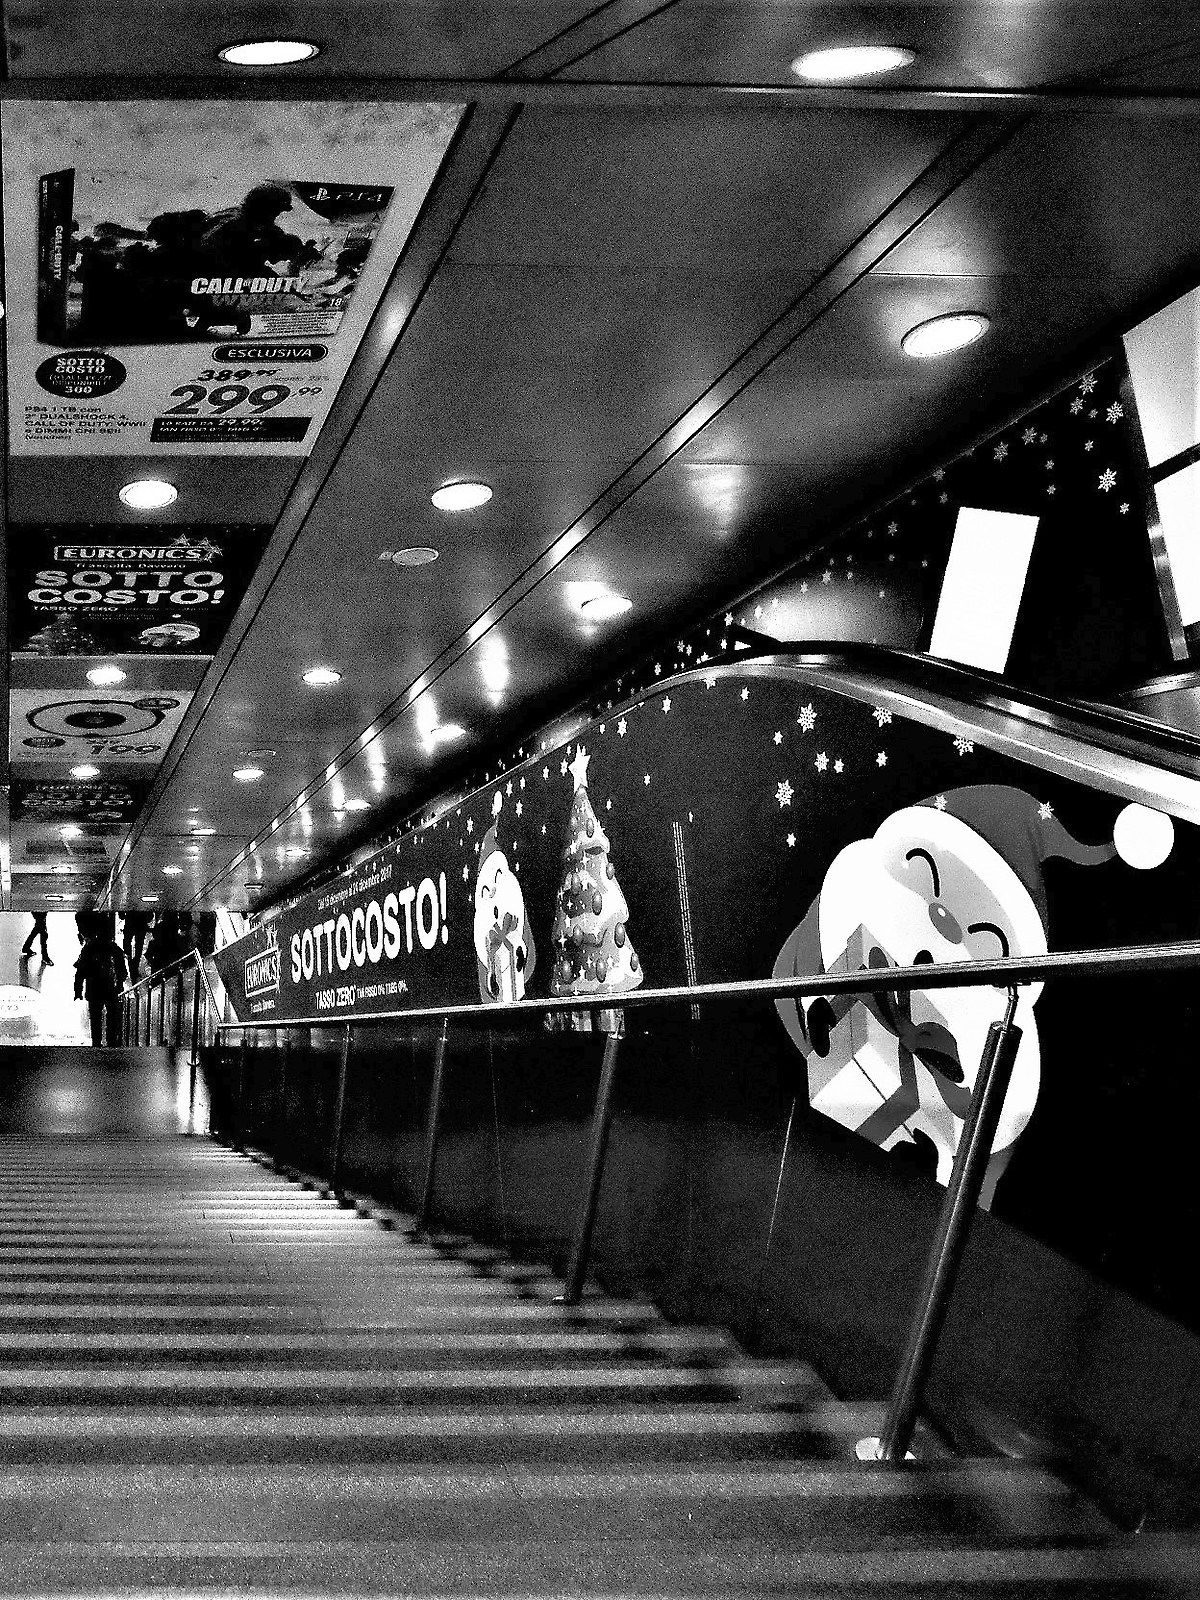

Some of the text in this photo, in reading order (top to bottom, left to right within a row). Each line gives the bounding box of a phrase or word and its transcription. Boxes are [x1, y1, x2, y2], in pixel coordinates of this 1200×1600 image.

[191, 277, 243, 295] CALL
[227, 348, 312, 359] ESCLUSIVA
[57, 358, 106, 366] SOTTO
[55, 365, 105, 374] COSTO
[64, 386, 93, 394] 300
[63, 548, 202, 559] EURONICS
[34, 570, 224, 588] SOTTO
[27, 588, 226, 604] COSTO!
[290, 871, 450, 984] SOTTOCOSTO!
[315, 989, 335, 1010] TASSO
